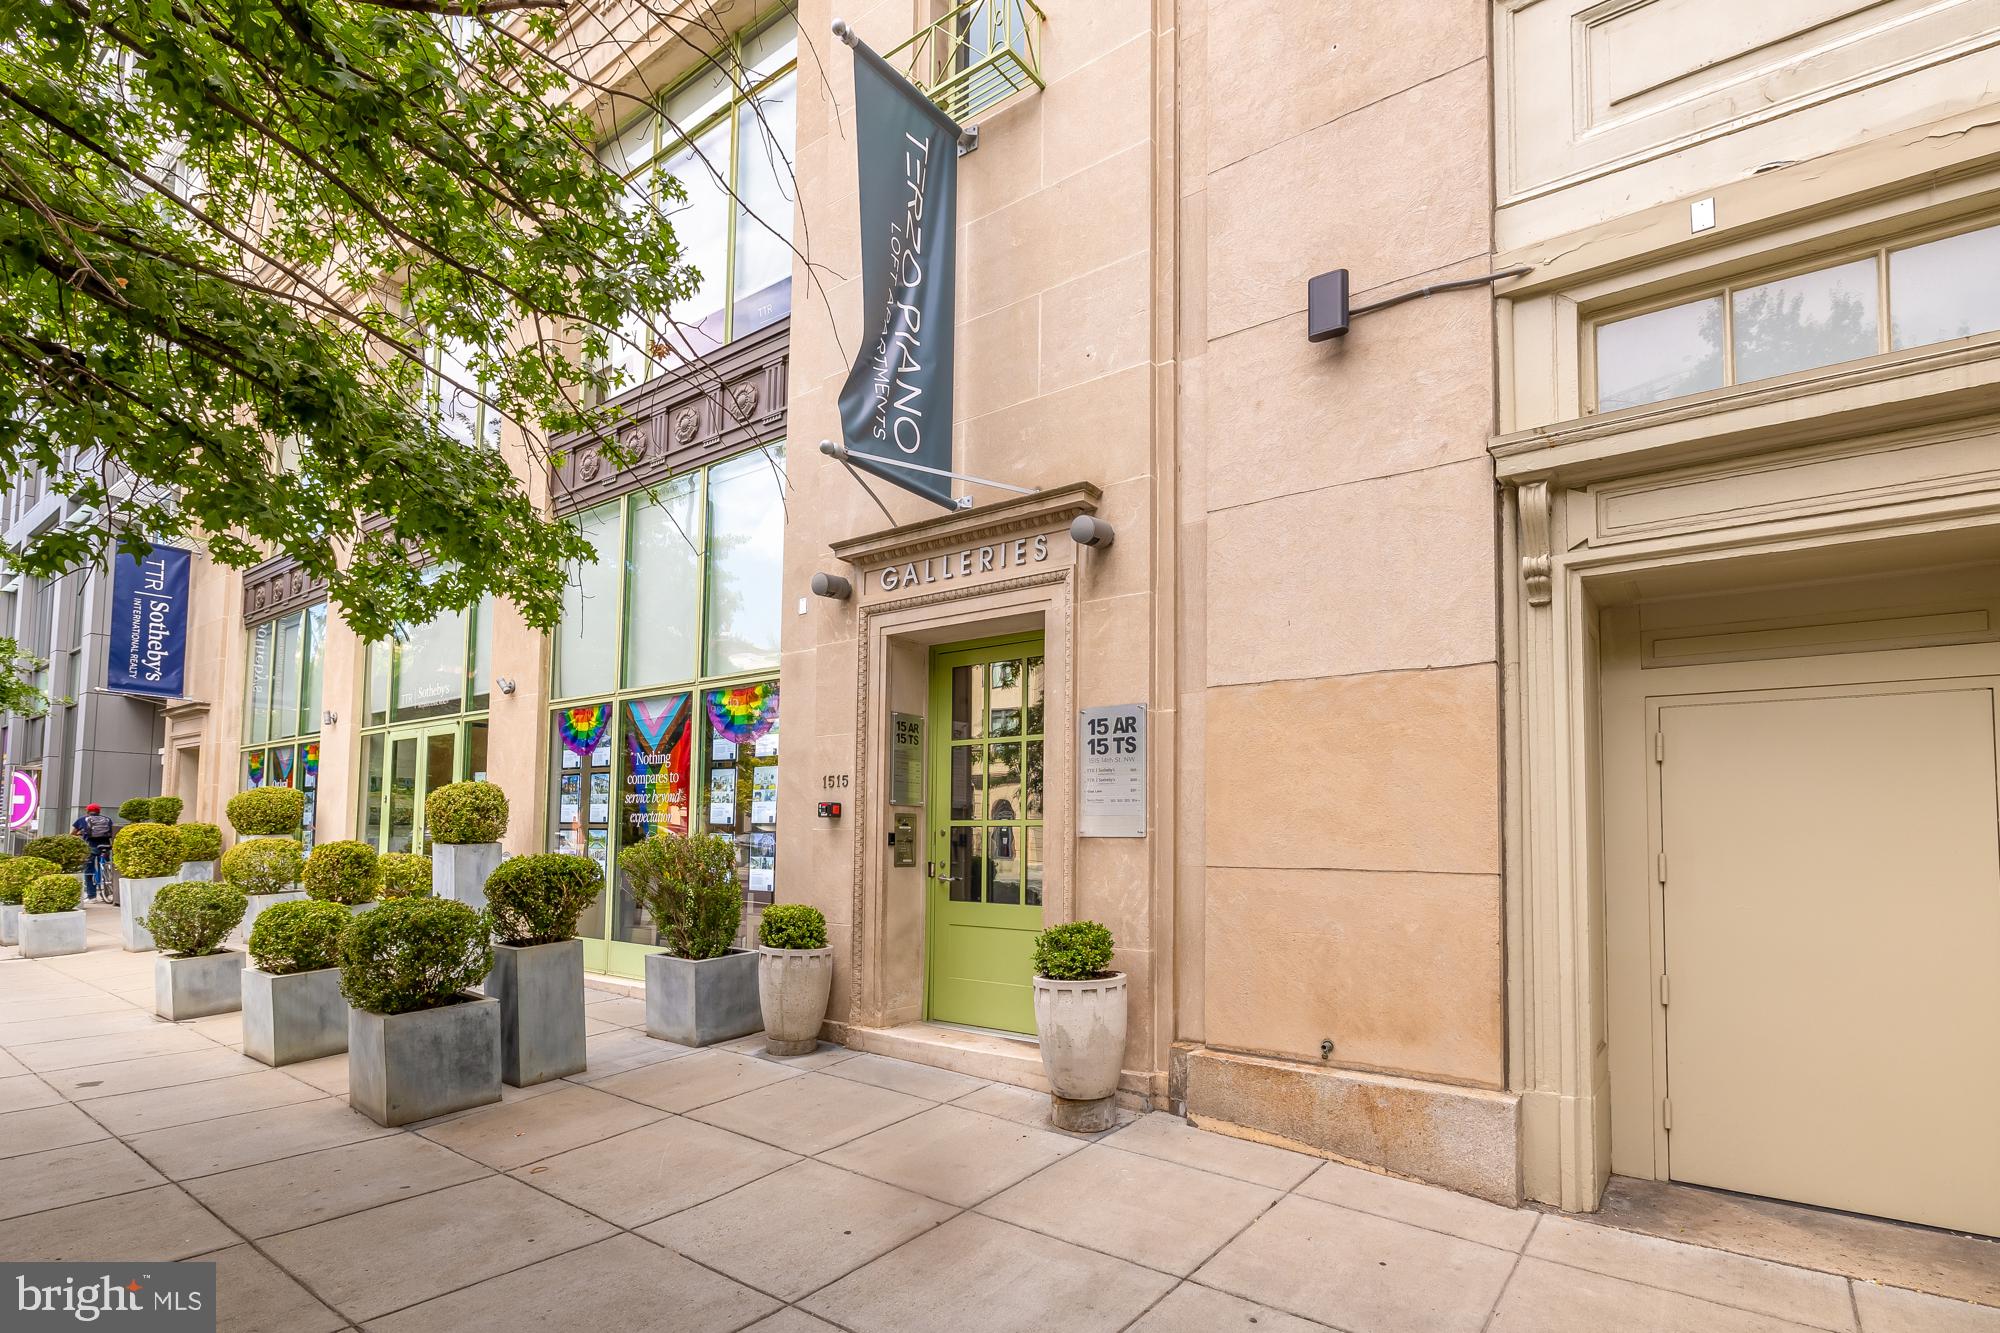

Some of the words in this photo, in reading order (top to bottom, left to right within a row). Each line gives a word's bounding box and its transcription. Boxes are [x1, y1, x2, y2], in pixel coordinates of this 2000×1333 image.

[901, 131, 930, 288] TERZO
[890, 221, 902, 287] LOFT
[872, 287, 895, 441] APARTMENTS
[893, 301, 922, 454] PIANO
[144, 559, 165, 589] TTR
[879, 534, 1049, 592] GALLERIES
[129, 597, 142, 653] INTERNATIONAL
[141, 600, 170, 682] Sotheby's
[128, 653, 139, 679] REALTY
[896, 721, 907, 732] 15
[908, 723, 920, 735] AR
[1087, 718, 1109, 736] 15
[1112, 716, 1137, 734] AR
[896, 733, 907, 744] 15
[908, 734, 920, 746] TS
[1087, 738, 1109, 755] 15
[1113, 736, 1137, 754] TS
[635, 751, 672, 768] Nothing
[626, 773, 668, 789] compares
[669, 772, 680, 783] to
[822, 774, 849, 790] 1515
[624, 790, 651, 804] service
[651, 788, 681, 807] beyond
[629, 809, 674, 828] expectation
